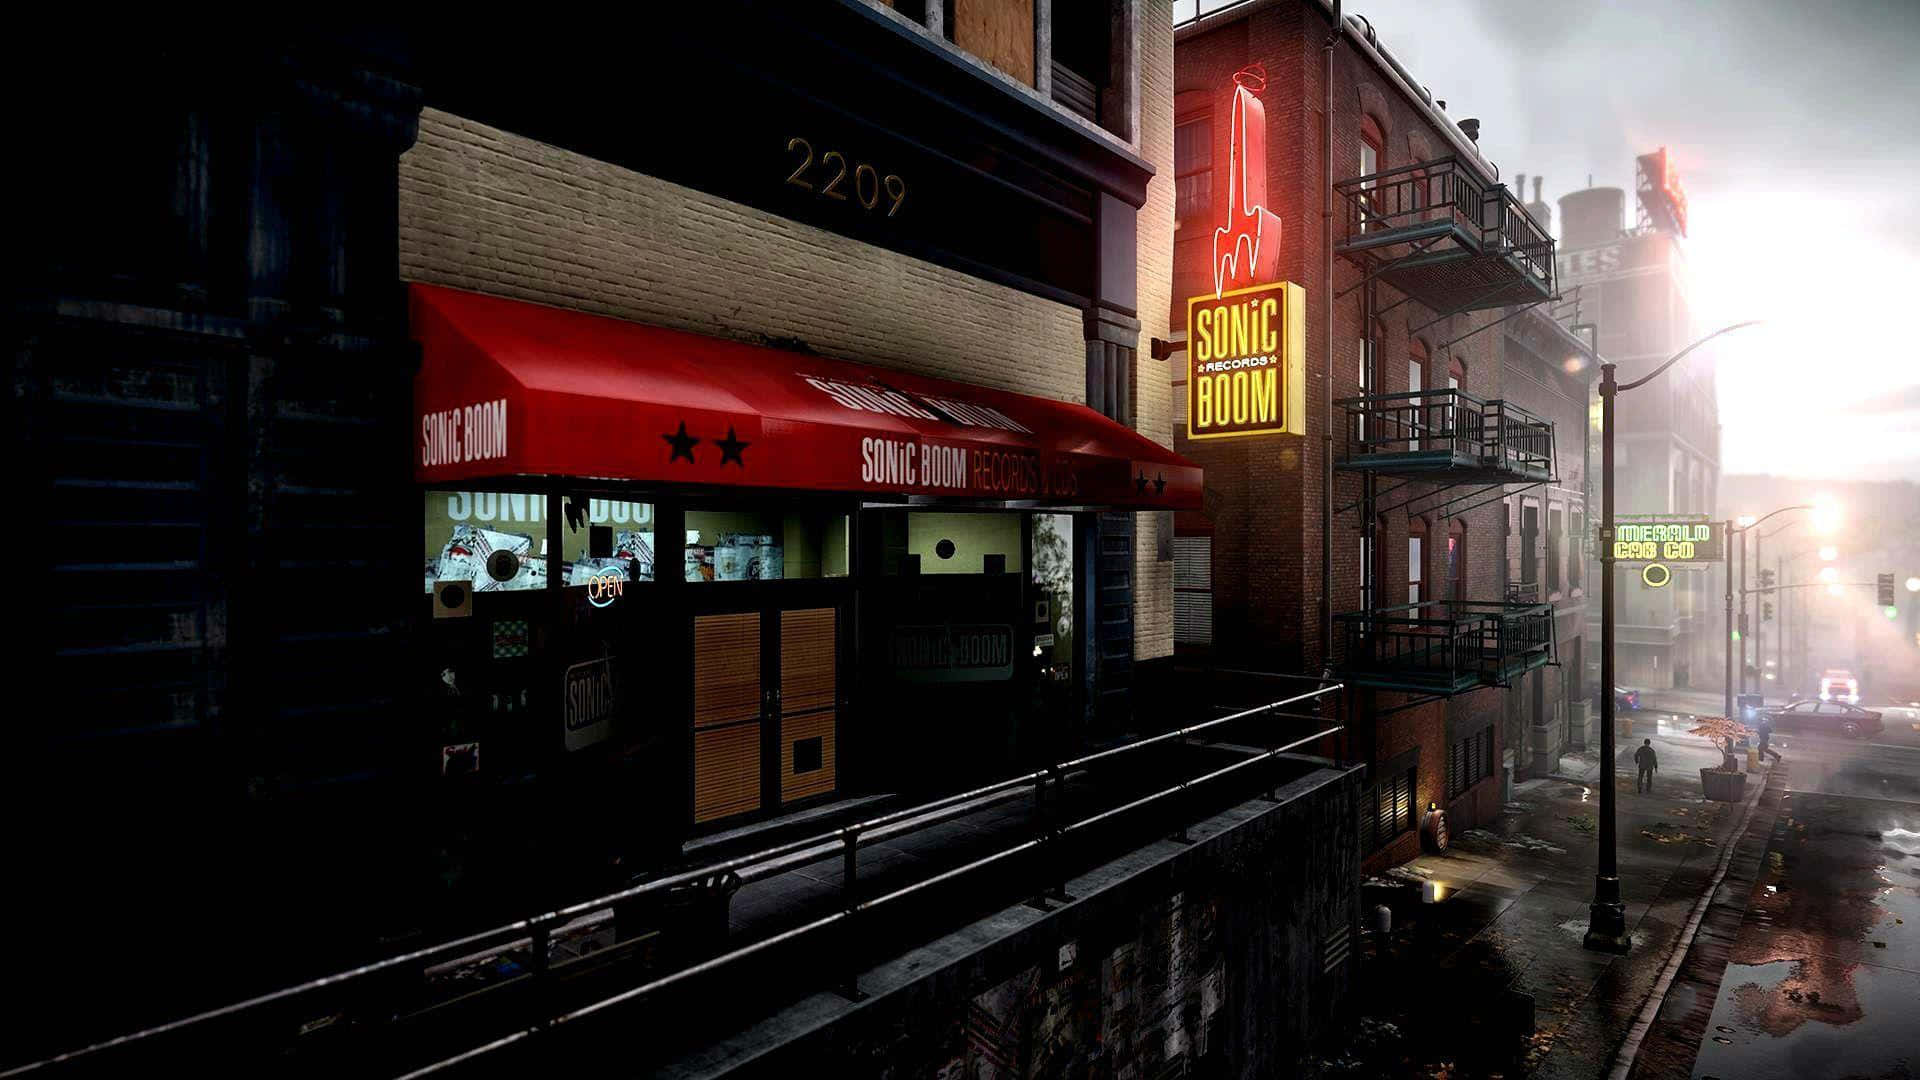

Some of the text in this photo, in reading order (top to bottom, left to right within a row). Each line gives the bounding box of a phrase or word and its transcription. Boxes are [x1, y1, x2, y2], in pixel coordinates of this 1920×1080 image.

[786, 137, 906, 217] 2209
[1206, 356, 1268, 372] RECORDS
[1197, 368, 1277, 428] BOOM
[464, 398, 507, 462] BOOM
[921, 444, 967, 489] BOOM
[1614, 542, 1694, 559] CAB CO
[1615, 525, 1710, 542] MERALD
[588, 574, 623, 600] OPEN
